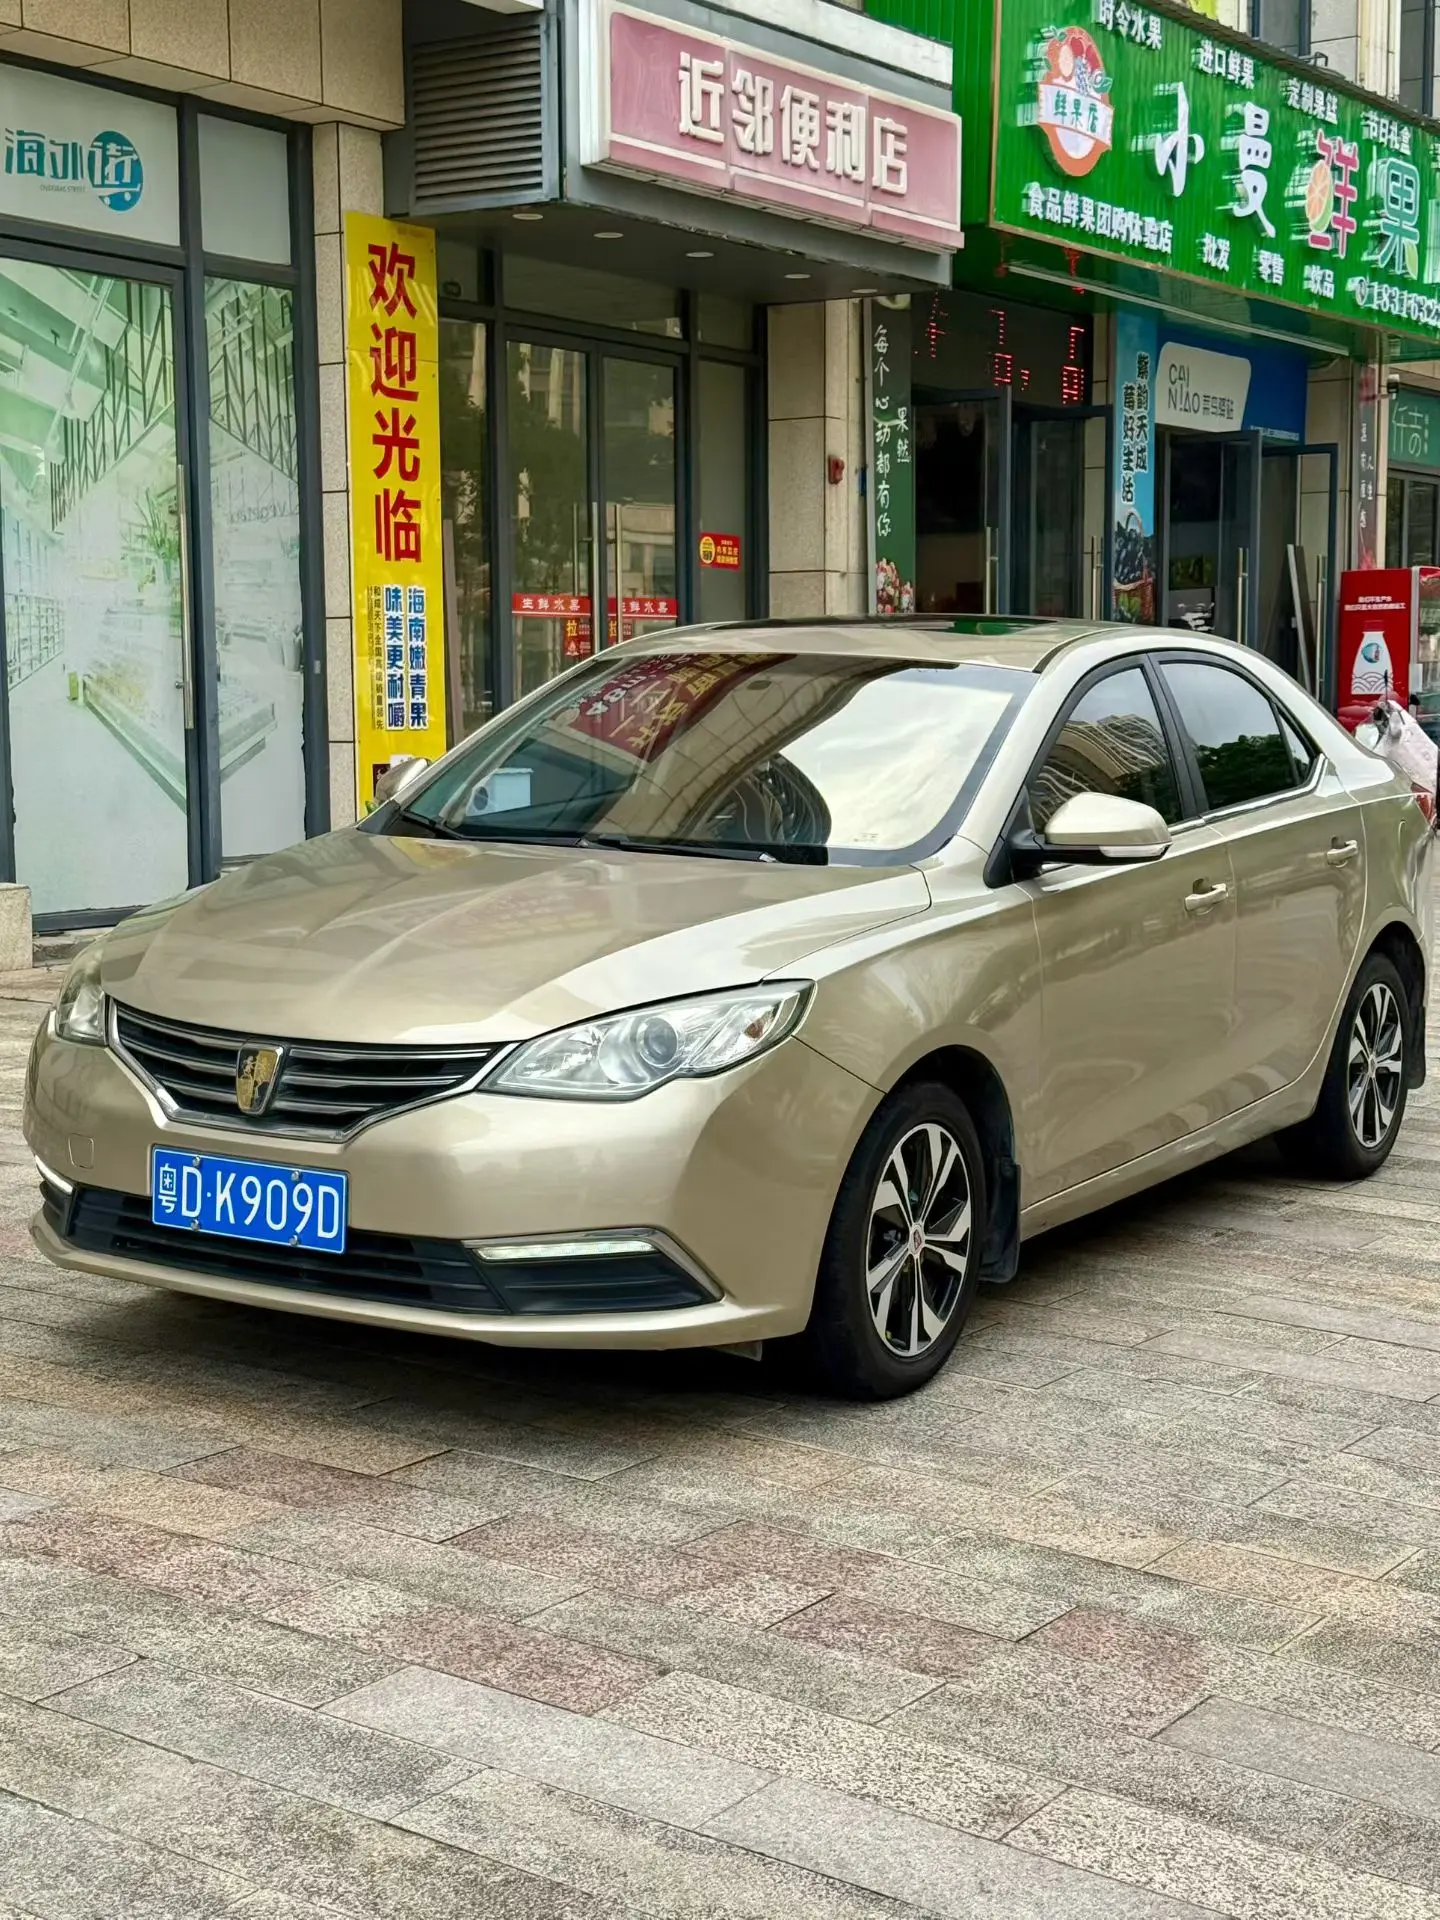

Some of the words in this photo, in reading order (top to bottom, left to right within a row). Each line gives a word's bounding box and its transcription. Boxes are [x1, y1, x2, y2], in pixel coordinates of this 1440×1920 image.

[1099, 0, 1162, 50] 时令水果
[1197, 39, 1255, 90] 进口鲜果
[678, 51, 908, 195] 近邻便利店
[1053, 90, 1098, 132] 鲜果店
[1366, 110, 1412, 156] 节日礼盒
[1028, 182, 1173, 255] 食品鲜果团购体验店
[1203, 232, 1230, 272] 批发
[1258, 250, 1284, 287] 零售
[1308, 265, 1335, 299] 饮品
[1169, 363, 1190, 388] CAI
[368, 242, 421, 562] 欢迎光临
[874, 324, 891, 537] 每个心动都有你
[896, 407, 910, 463] 果然
[521, 597, 581, 612] 生鲜水果
[566, 619, 578, 637] 拉
[384, 587, 405, 728] 味美更耐嚼
[408, 587, 427, 728] 海南嫩青果
[158, 1163, 339, 1239] 粤D·K909D
